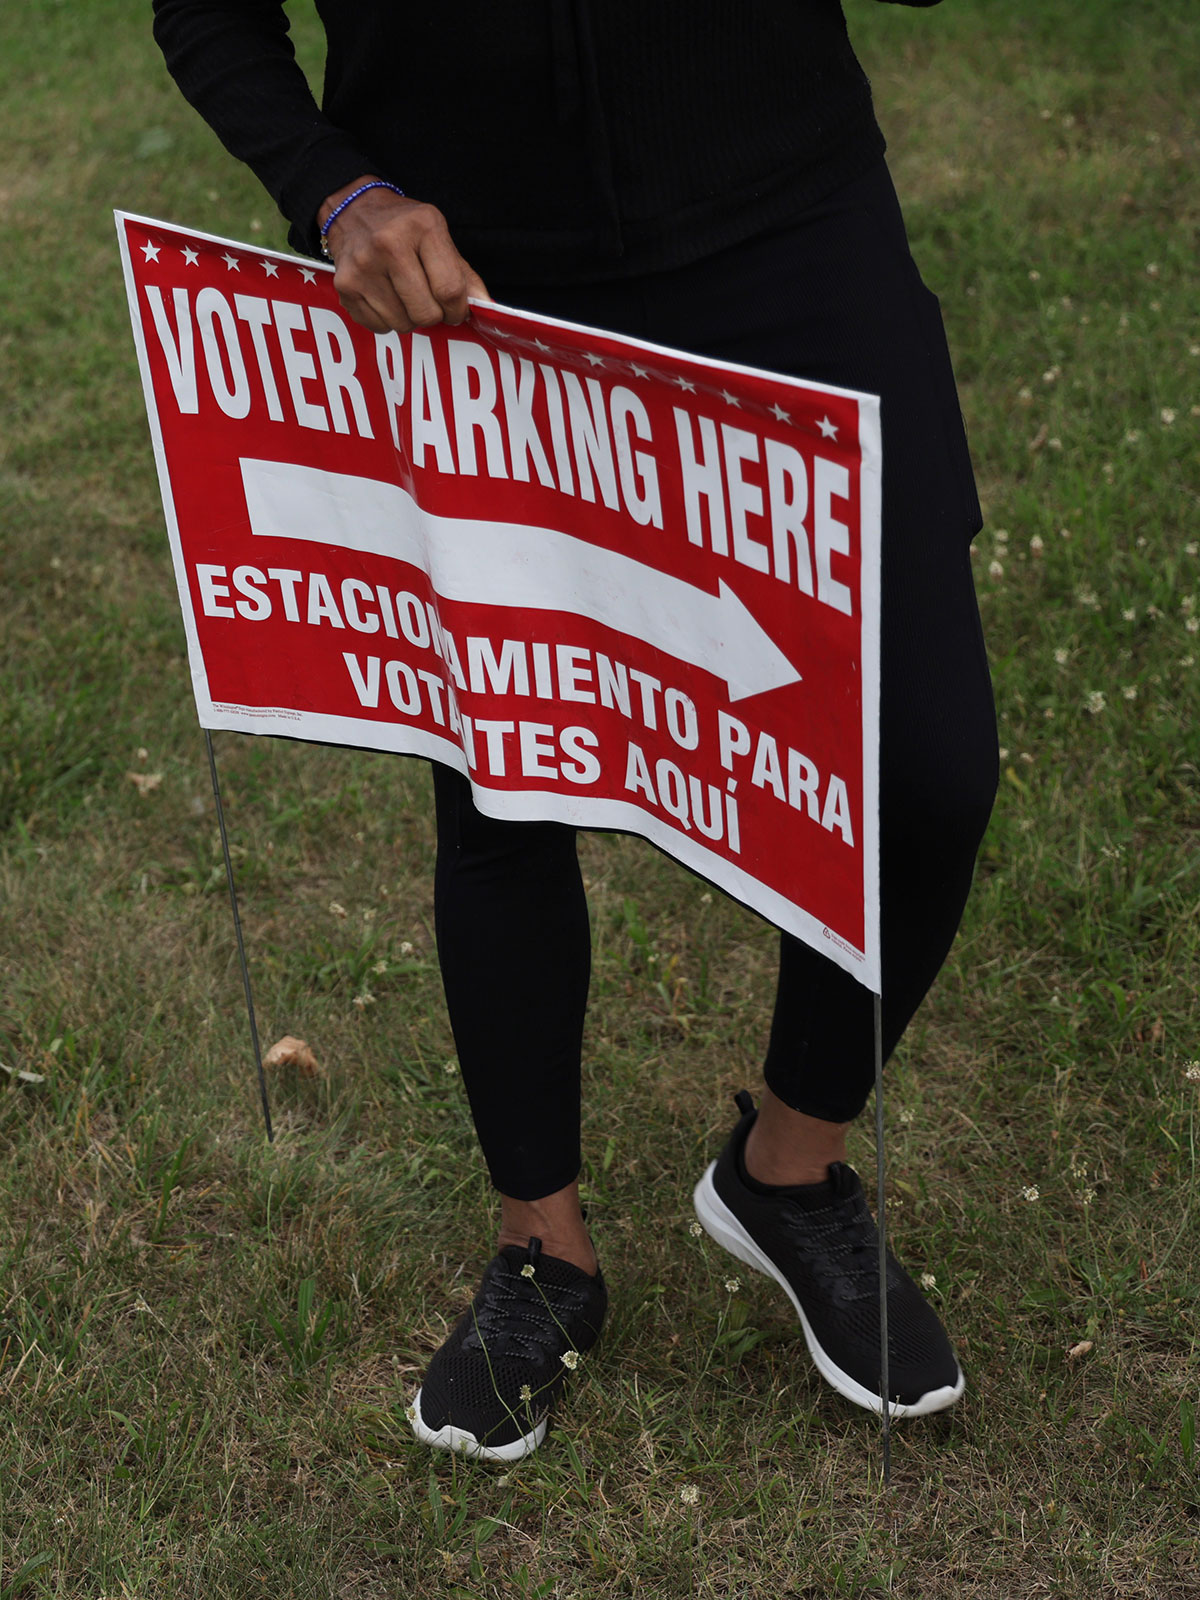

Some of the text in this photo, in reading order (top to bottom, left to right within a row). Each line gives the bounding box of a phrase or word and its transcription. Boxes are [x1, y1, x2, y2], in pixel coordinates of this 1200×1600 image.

[144, 285, 853, 617] VOTER PARKING HERE
[195, 563, 855, 848] ESTACIONAMIENTO PARA
[624, 741, 741, 855] AQUÍ
